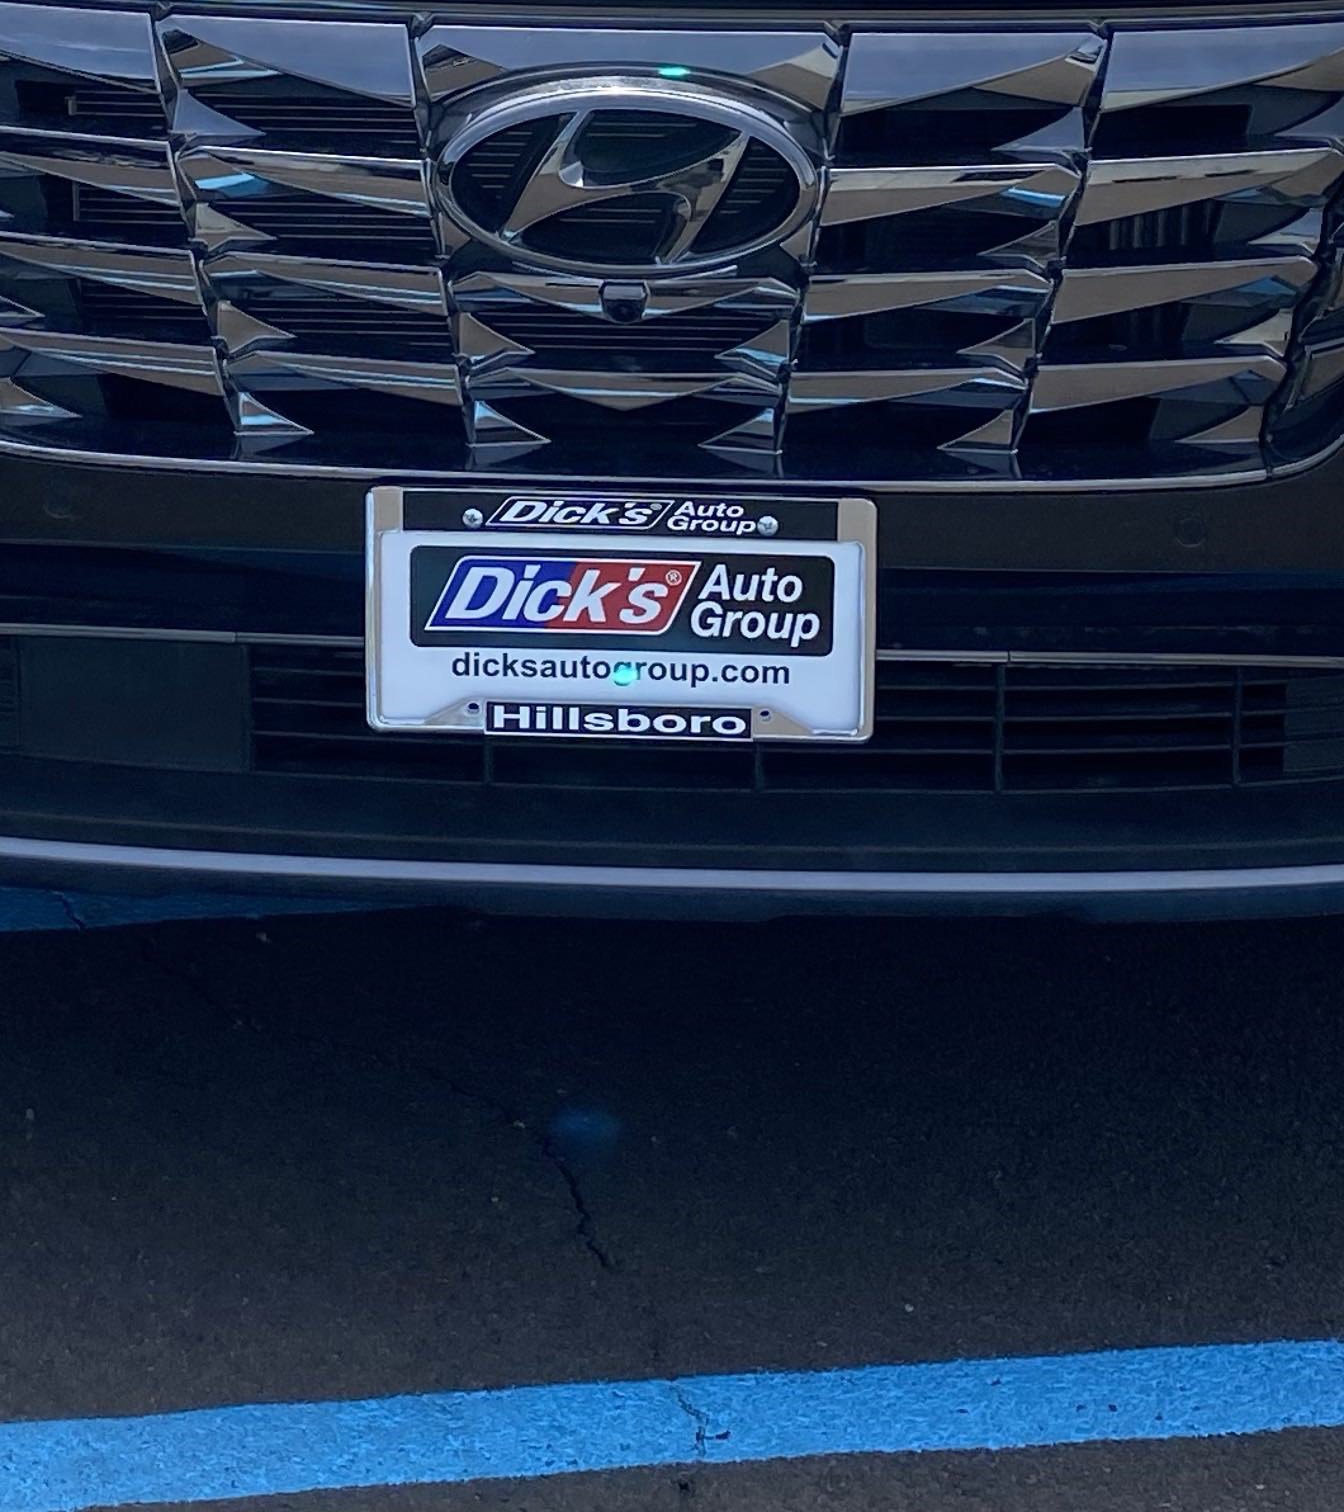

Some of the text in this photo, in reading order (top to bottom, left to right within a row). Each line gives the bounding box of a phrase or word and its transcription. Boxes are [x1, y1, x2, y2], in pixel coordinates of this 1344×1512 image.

[674, 501, 744, 518] Auto
[667, 517, 756, 535] Group
[698, 565, 803, 603] Auto
[691, 606, 820, 647] Group
[493, 705, 747, 735] Hillsboro
